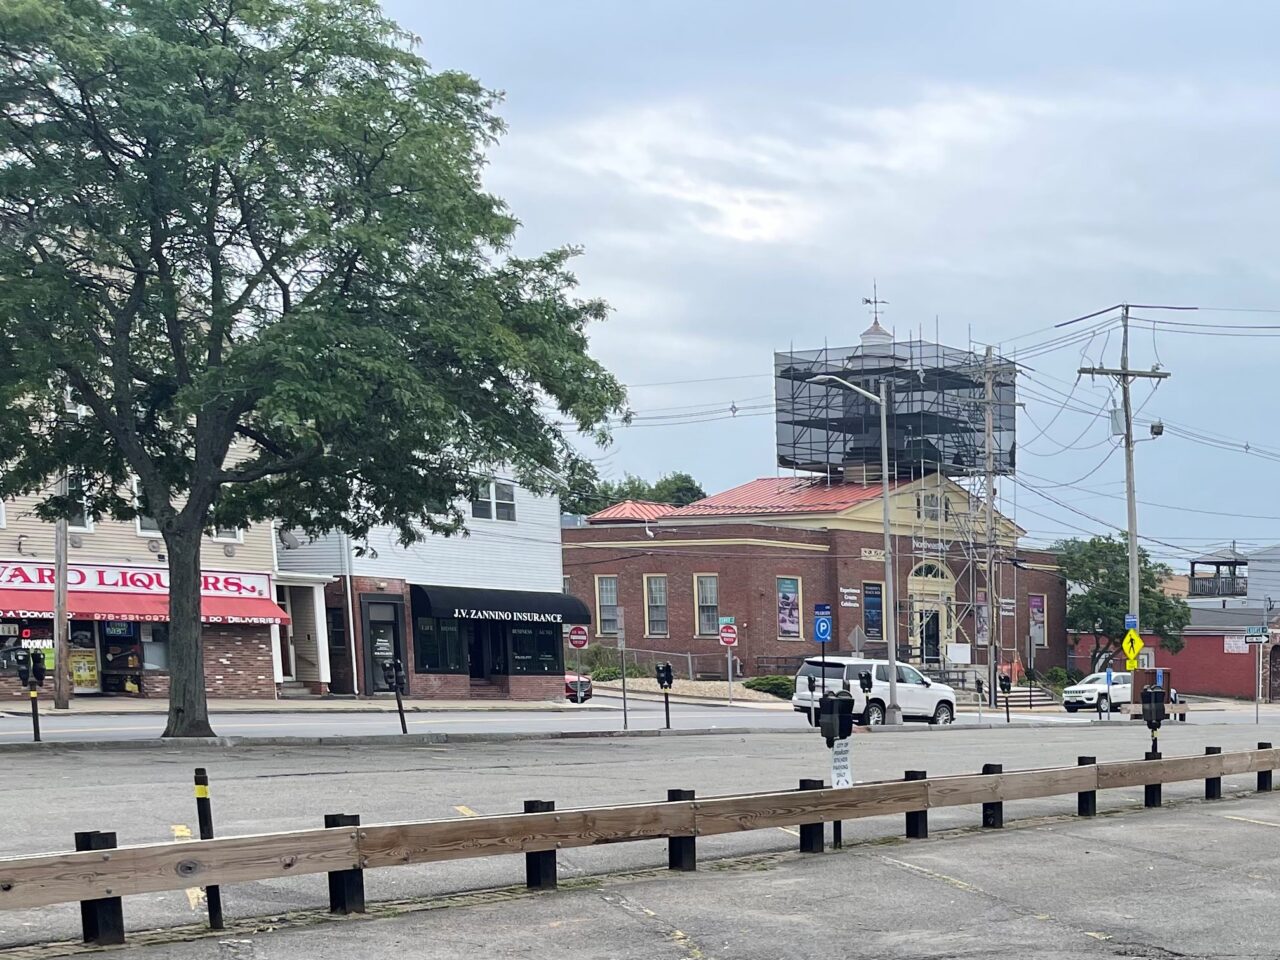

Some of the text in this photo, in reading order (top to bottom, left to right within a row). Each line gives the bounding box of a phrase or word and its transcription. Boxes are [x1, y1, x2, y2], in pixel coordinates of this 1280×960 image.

[96, 570, 256, 593] LIQURS
[454, 608, 563, 623] J.V. ZANNINO INSURANCE
[820, 622, 827, 633] P
[21, 639, 53, 649] HOOKAH
